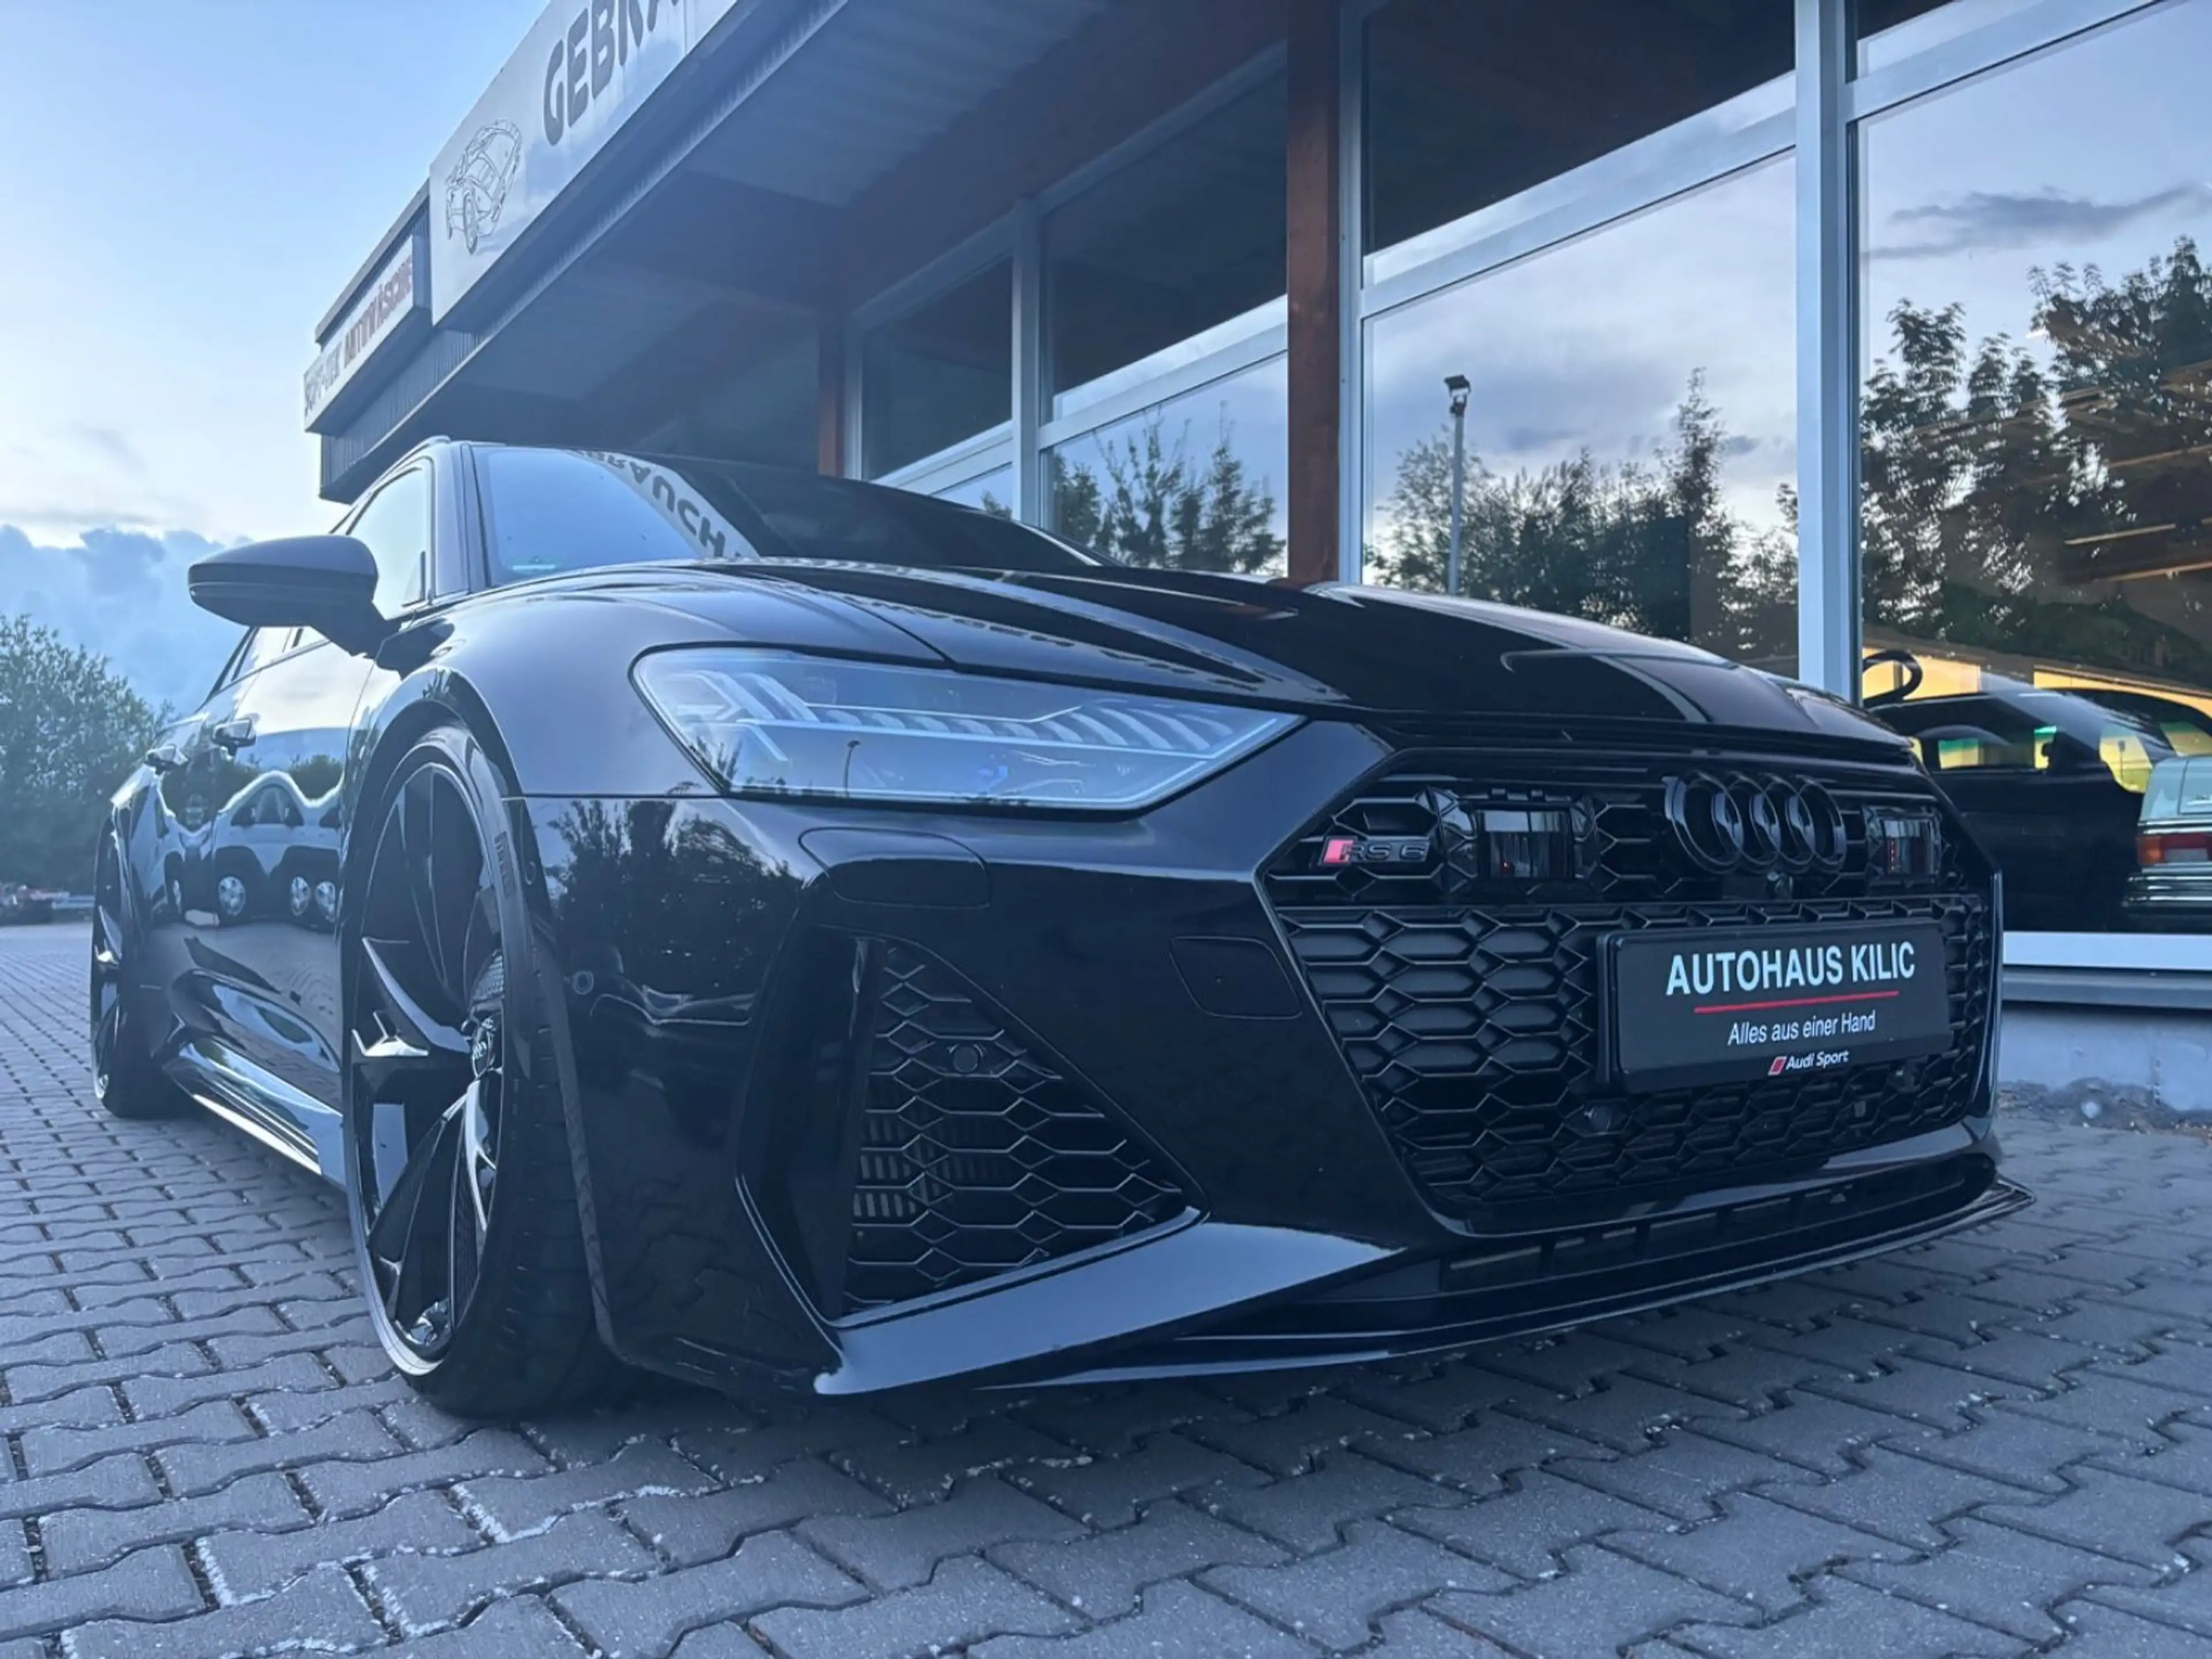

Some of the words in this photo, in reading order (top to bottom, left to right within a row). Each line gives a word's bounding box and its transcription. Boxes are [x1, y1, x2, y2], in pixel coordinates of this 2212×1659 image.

[544, 0, 680, 146] GEBR
[1400, 842, 1426, 861] 6
[1666, 945, 1843, 996] AUTOHAUS
[1851, 941, 1915, 982] KILIC
[1728, 1021, 1767, 1046] Alles
[1771, 1022, 1800, 1041] aus
[1802, 1016, 1839, 1038] einer
[1841, 1009, 1876, 1033] Hand
[1785, 1052, 1815, 1070] Audi
[1816, 1049, 1850, 1069] Sport
